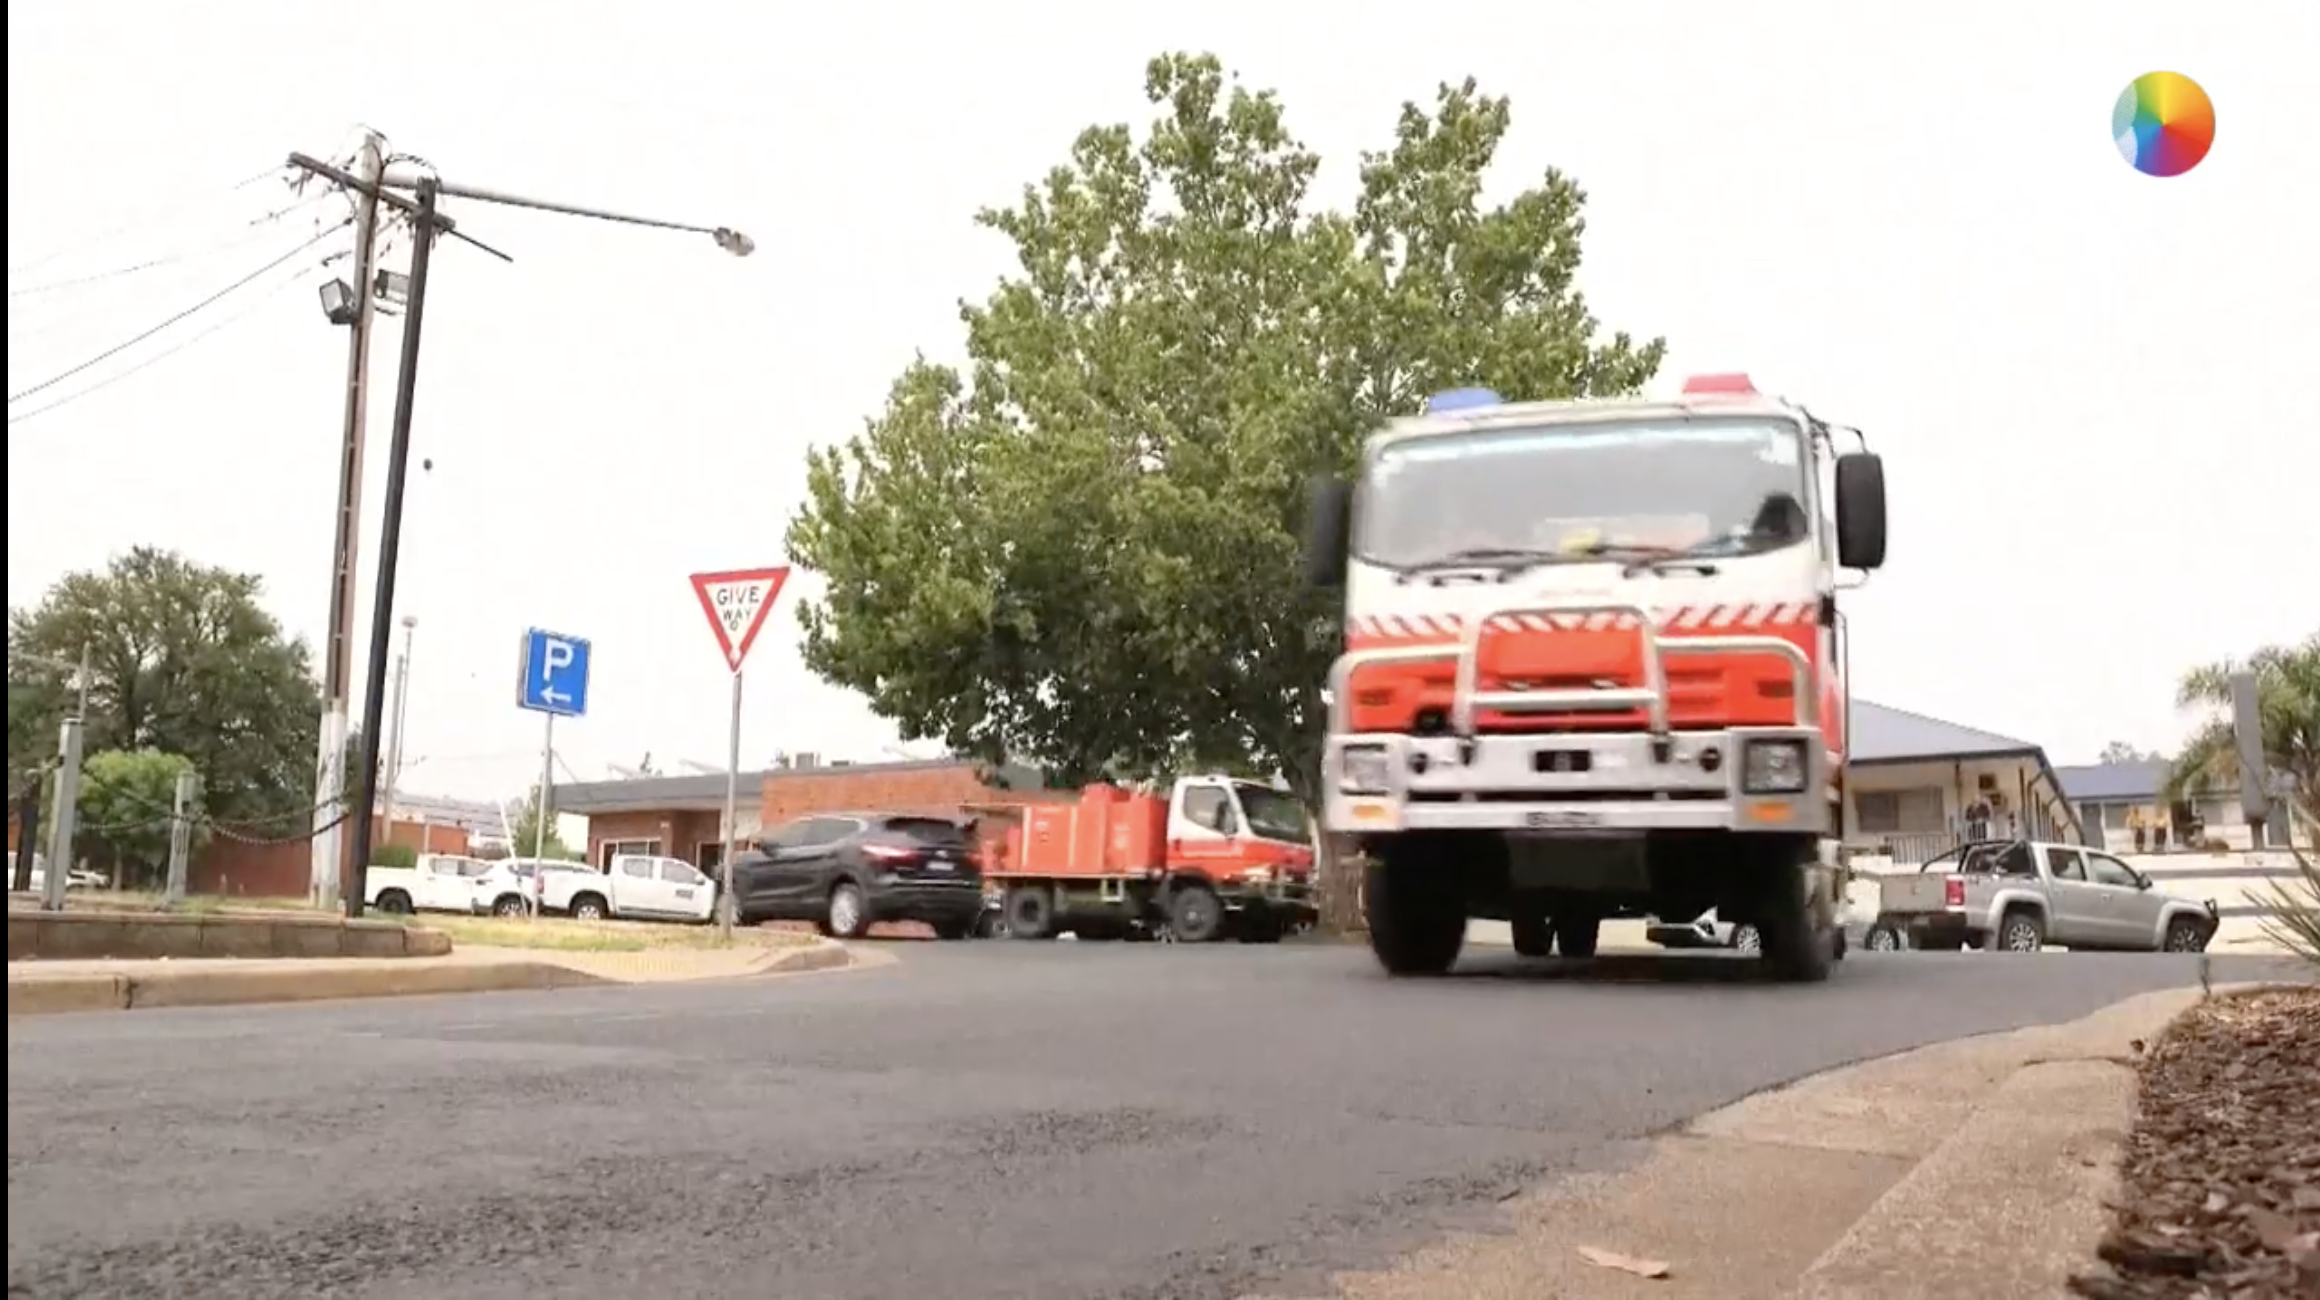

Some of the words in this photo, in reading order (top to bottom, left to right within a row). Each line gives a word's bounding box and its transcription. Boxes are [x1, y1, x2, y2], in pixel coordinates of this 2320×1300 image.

[716, 586, 760, 606] GIVE
[723, 607, 751, 621] WAY
[543, 638, 574, 681] P
